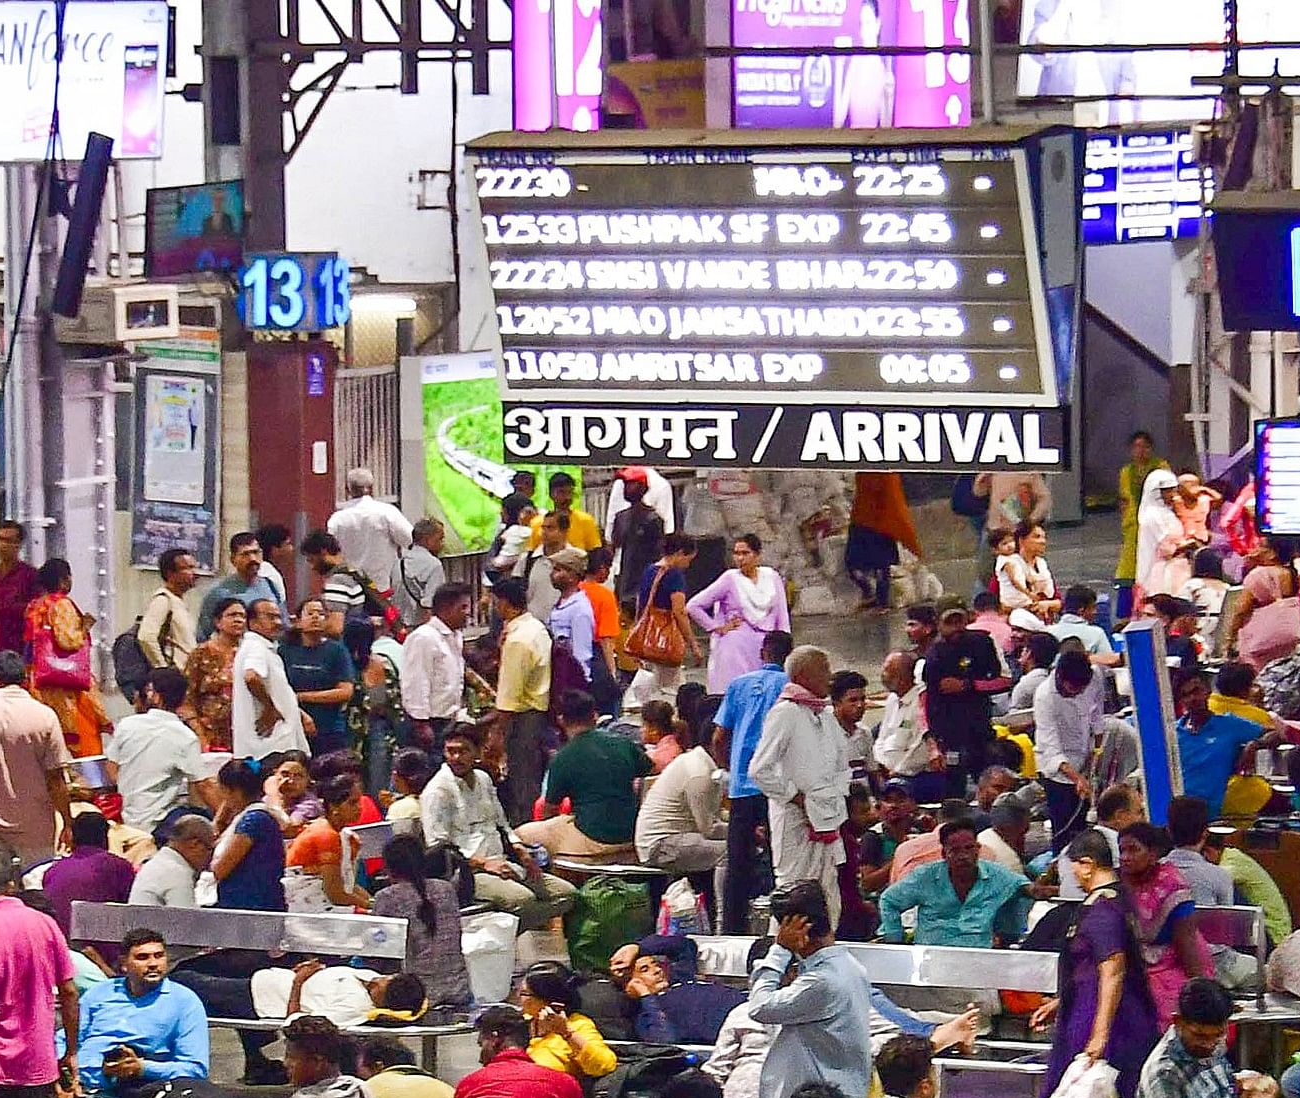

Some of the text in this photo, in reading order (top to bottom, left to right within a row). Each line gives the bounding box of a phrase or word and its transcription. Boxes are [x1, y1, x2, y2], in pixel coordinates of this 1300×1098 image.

[475, 167, 572, 197] 22230
[852, 165, 946, 196] 22:25
[481, 214, 578, 244] 12533
[578, 214, 840, 244] PUSHPAK SF EXP
[860, 213, 952, 243] 22:45
[660, 260, 772, 289] VANDE
[243, 259, 303, 328] 13
[320, 258, 351, 326] 13
[496, 306, 591, 335] 12052
[592, 306, 667, 335] MAO
[504, 352, 599, 381] 11058
[761, 354, 824, 382] EXP
[879, 354, 972, 383] 00:05
[503, 408, 739, 459] आगमन
[800, 410, 1061, 465] ARRIVAL
